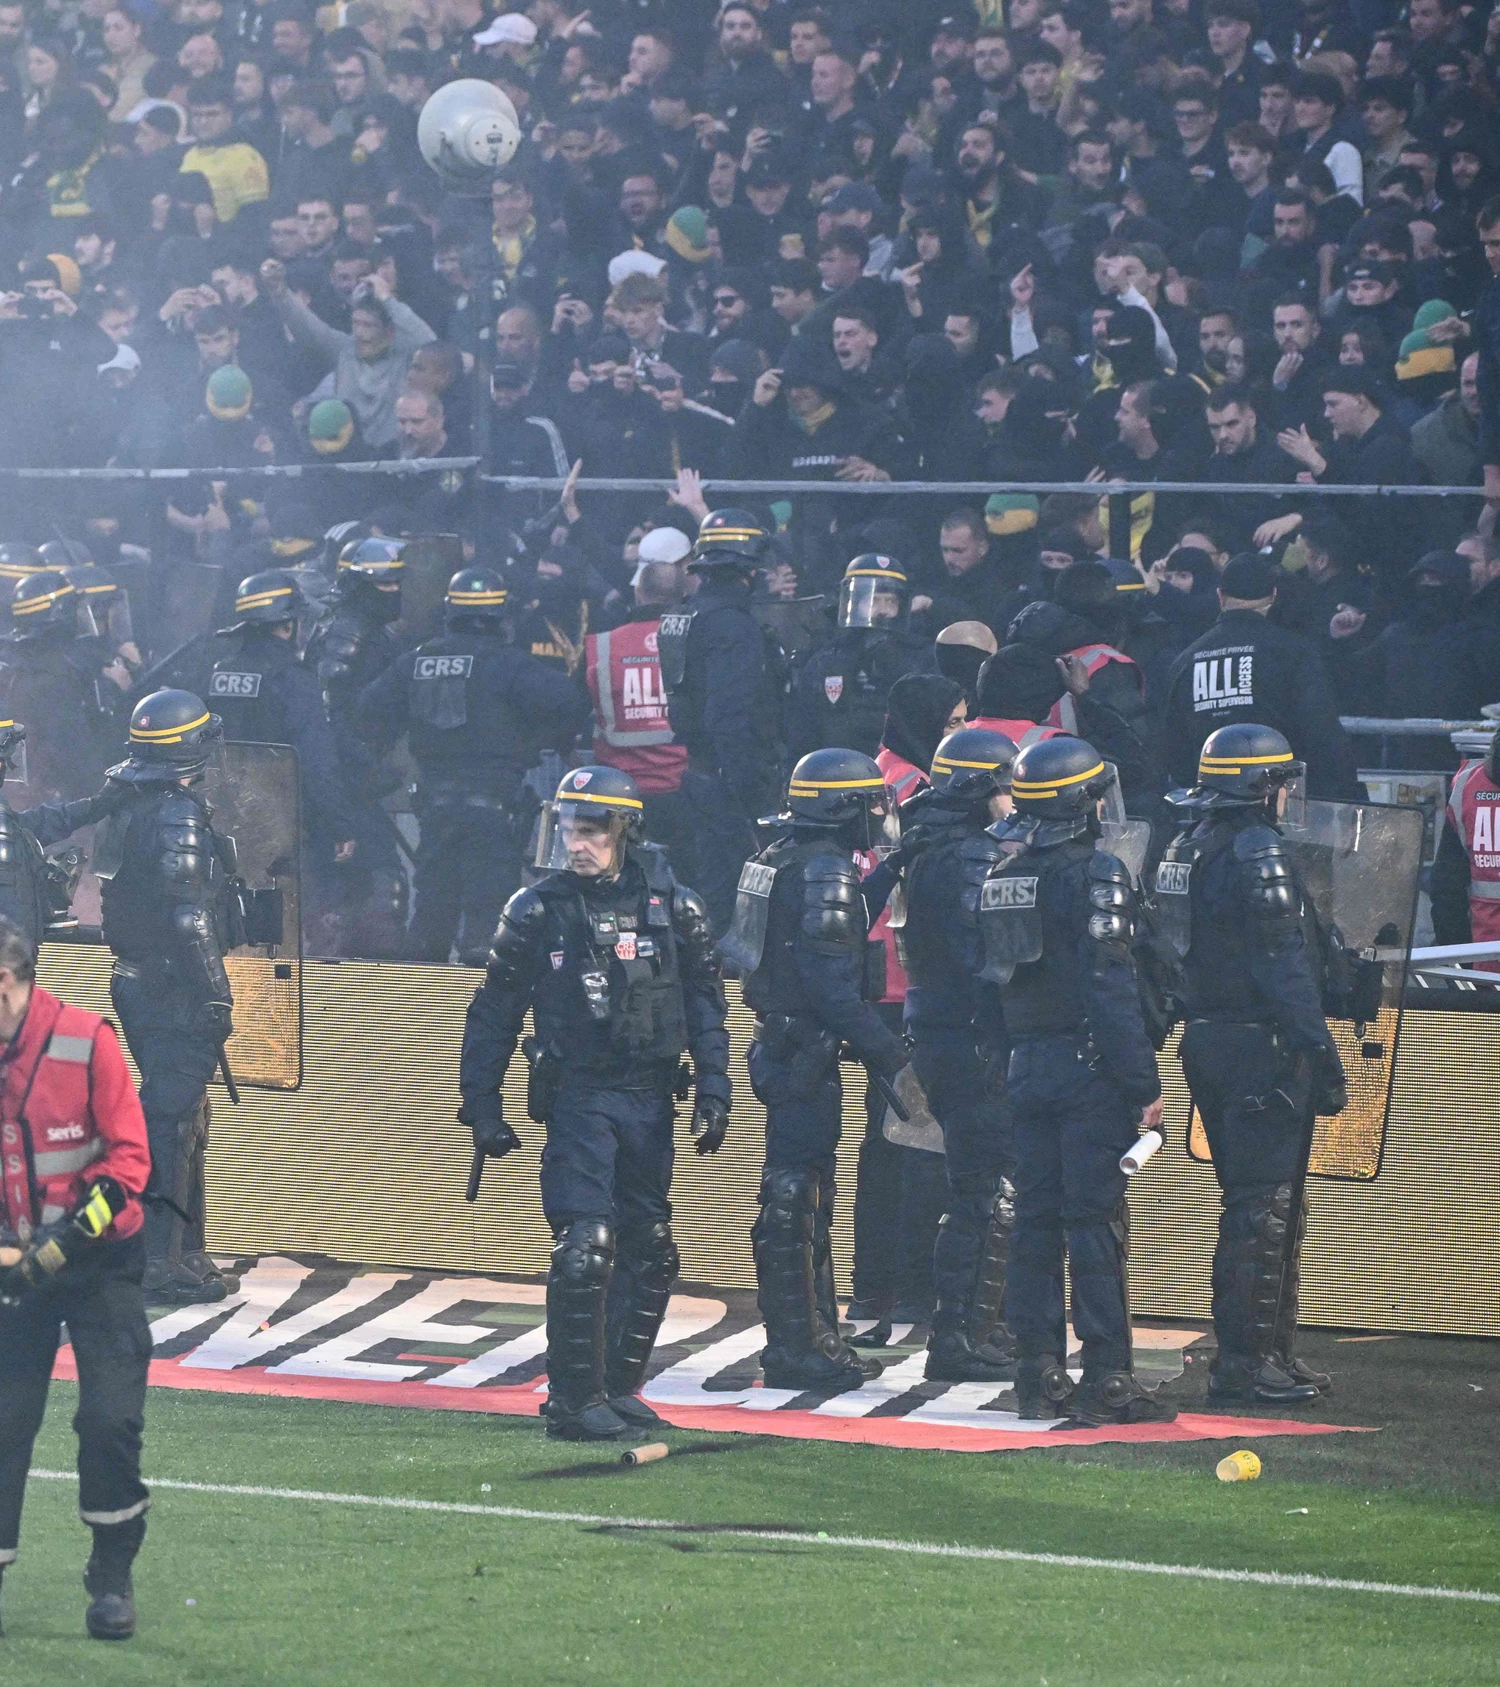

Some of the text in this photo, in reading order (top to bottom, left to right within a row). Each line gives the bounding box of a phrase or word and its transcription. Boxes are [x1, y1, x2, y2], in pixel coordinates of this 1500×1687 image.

[660, 617, 686, 636] CRS
[419, 657, 466, 677] CRS
[1238, 655, 1253, 695] ACCESS
[214, 674, 254, 694] CRS
[1193, 657, 1238, 701] ALL
[1158, 864, 1185, 891] CRS
[986, 878, 1031, 908] CRS
[617, 942, 635, 950] CRS
[46, 1122, 85, 1141] seris
